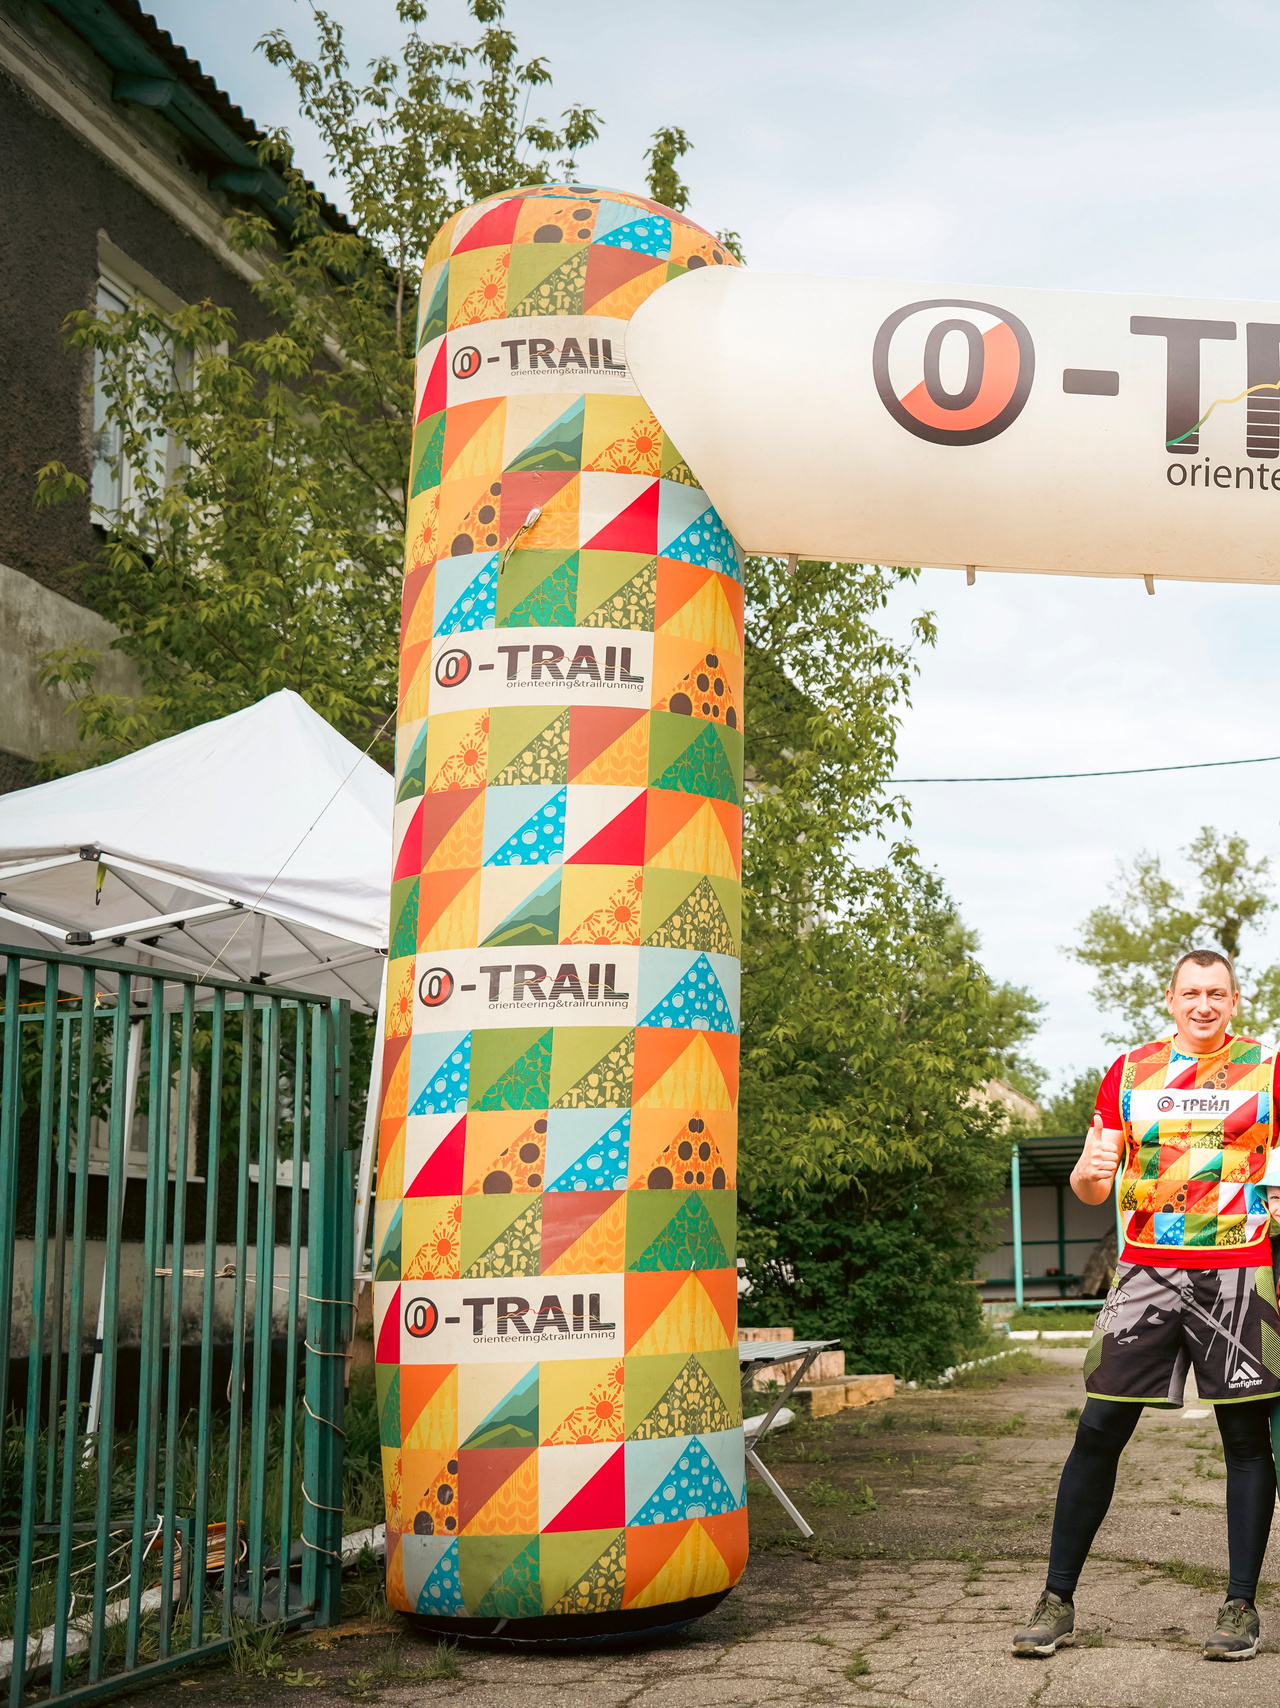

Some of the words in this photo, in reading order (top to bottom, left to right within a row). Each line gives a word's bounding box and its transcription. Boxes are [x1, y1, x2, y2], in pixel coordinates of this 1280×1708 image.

[511, 367, 626, 378] orienteering&trailrunning
[506, 679, 644, 692] orienteering&trailrunning
[488, 998, 629, 1010] orienteering&trailrunning
[473, 1329, 616, 1344] orienteering&trailrunning
